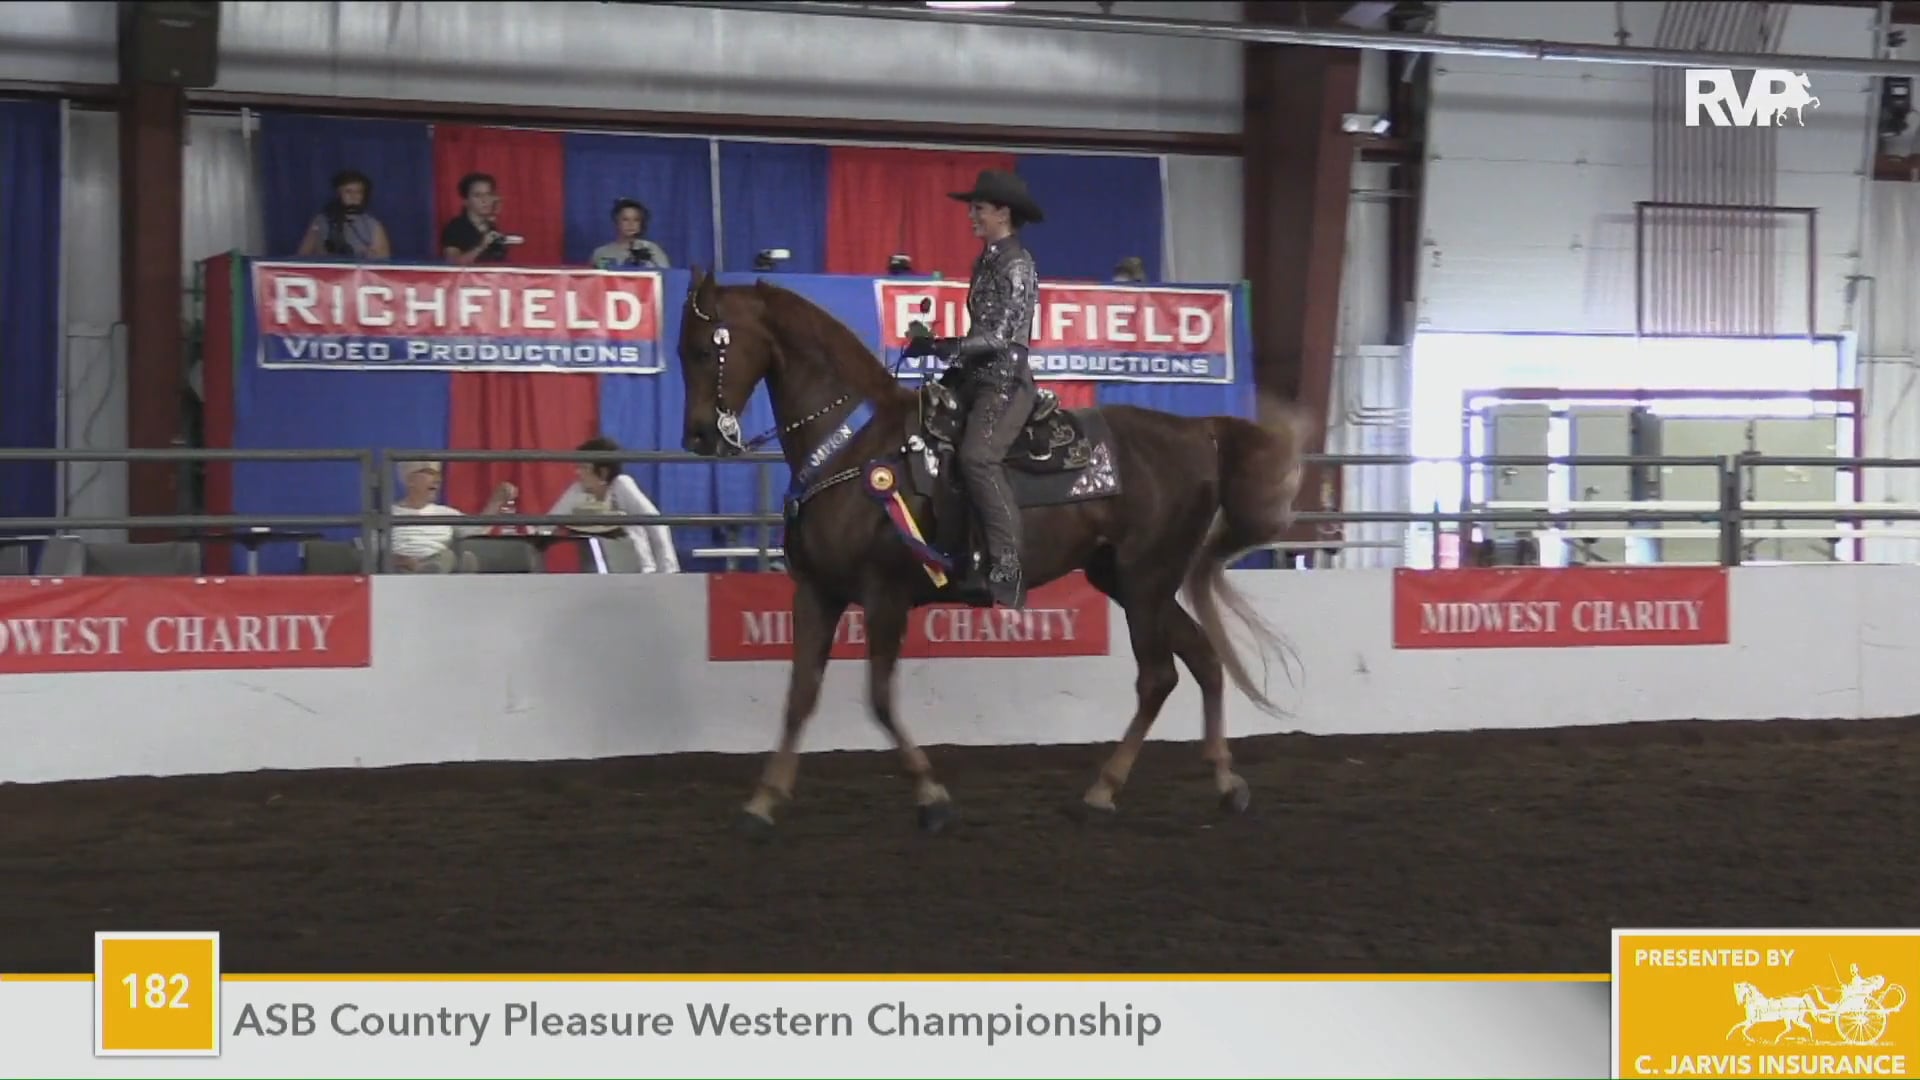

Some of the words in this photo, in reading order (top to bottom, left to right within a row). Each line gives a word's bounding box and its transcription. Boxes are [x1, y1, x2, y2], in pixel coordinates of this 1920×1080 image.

[274, 276, 642, 331] RICHFIELD
[895, 294, 1214, 344] RIFIELD
[283, 339, 390, 361] VIDEO
[406, 340, 640, 364] PRODUCTIONS
[1028, 354, 1210, 375] RODUCTIONS
[146, 614, 336, 654] CHARITY
[924, 608, 1080, 643] CHARITY
[1420, 602, 1561, 634] MIDWEST
[1572, 600, 1703, 631] CHARITY
